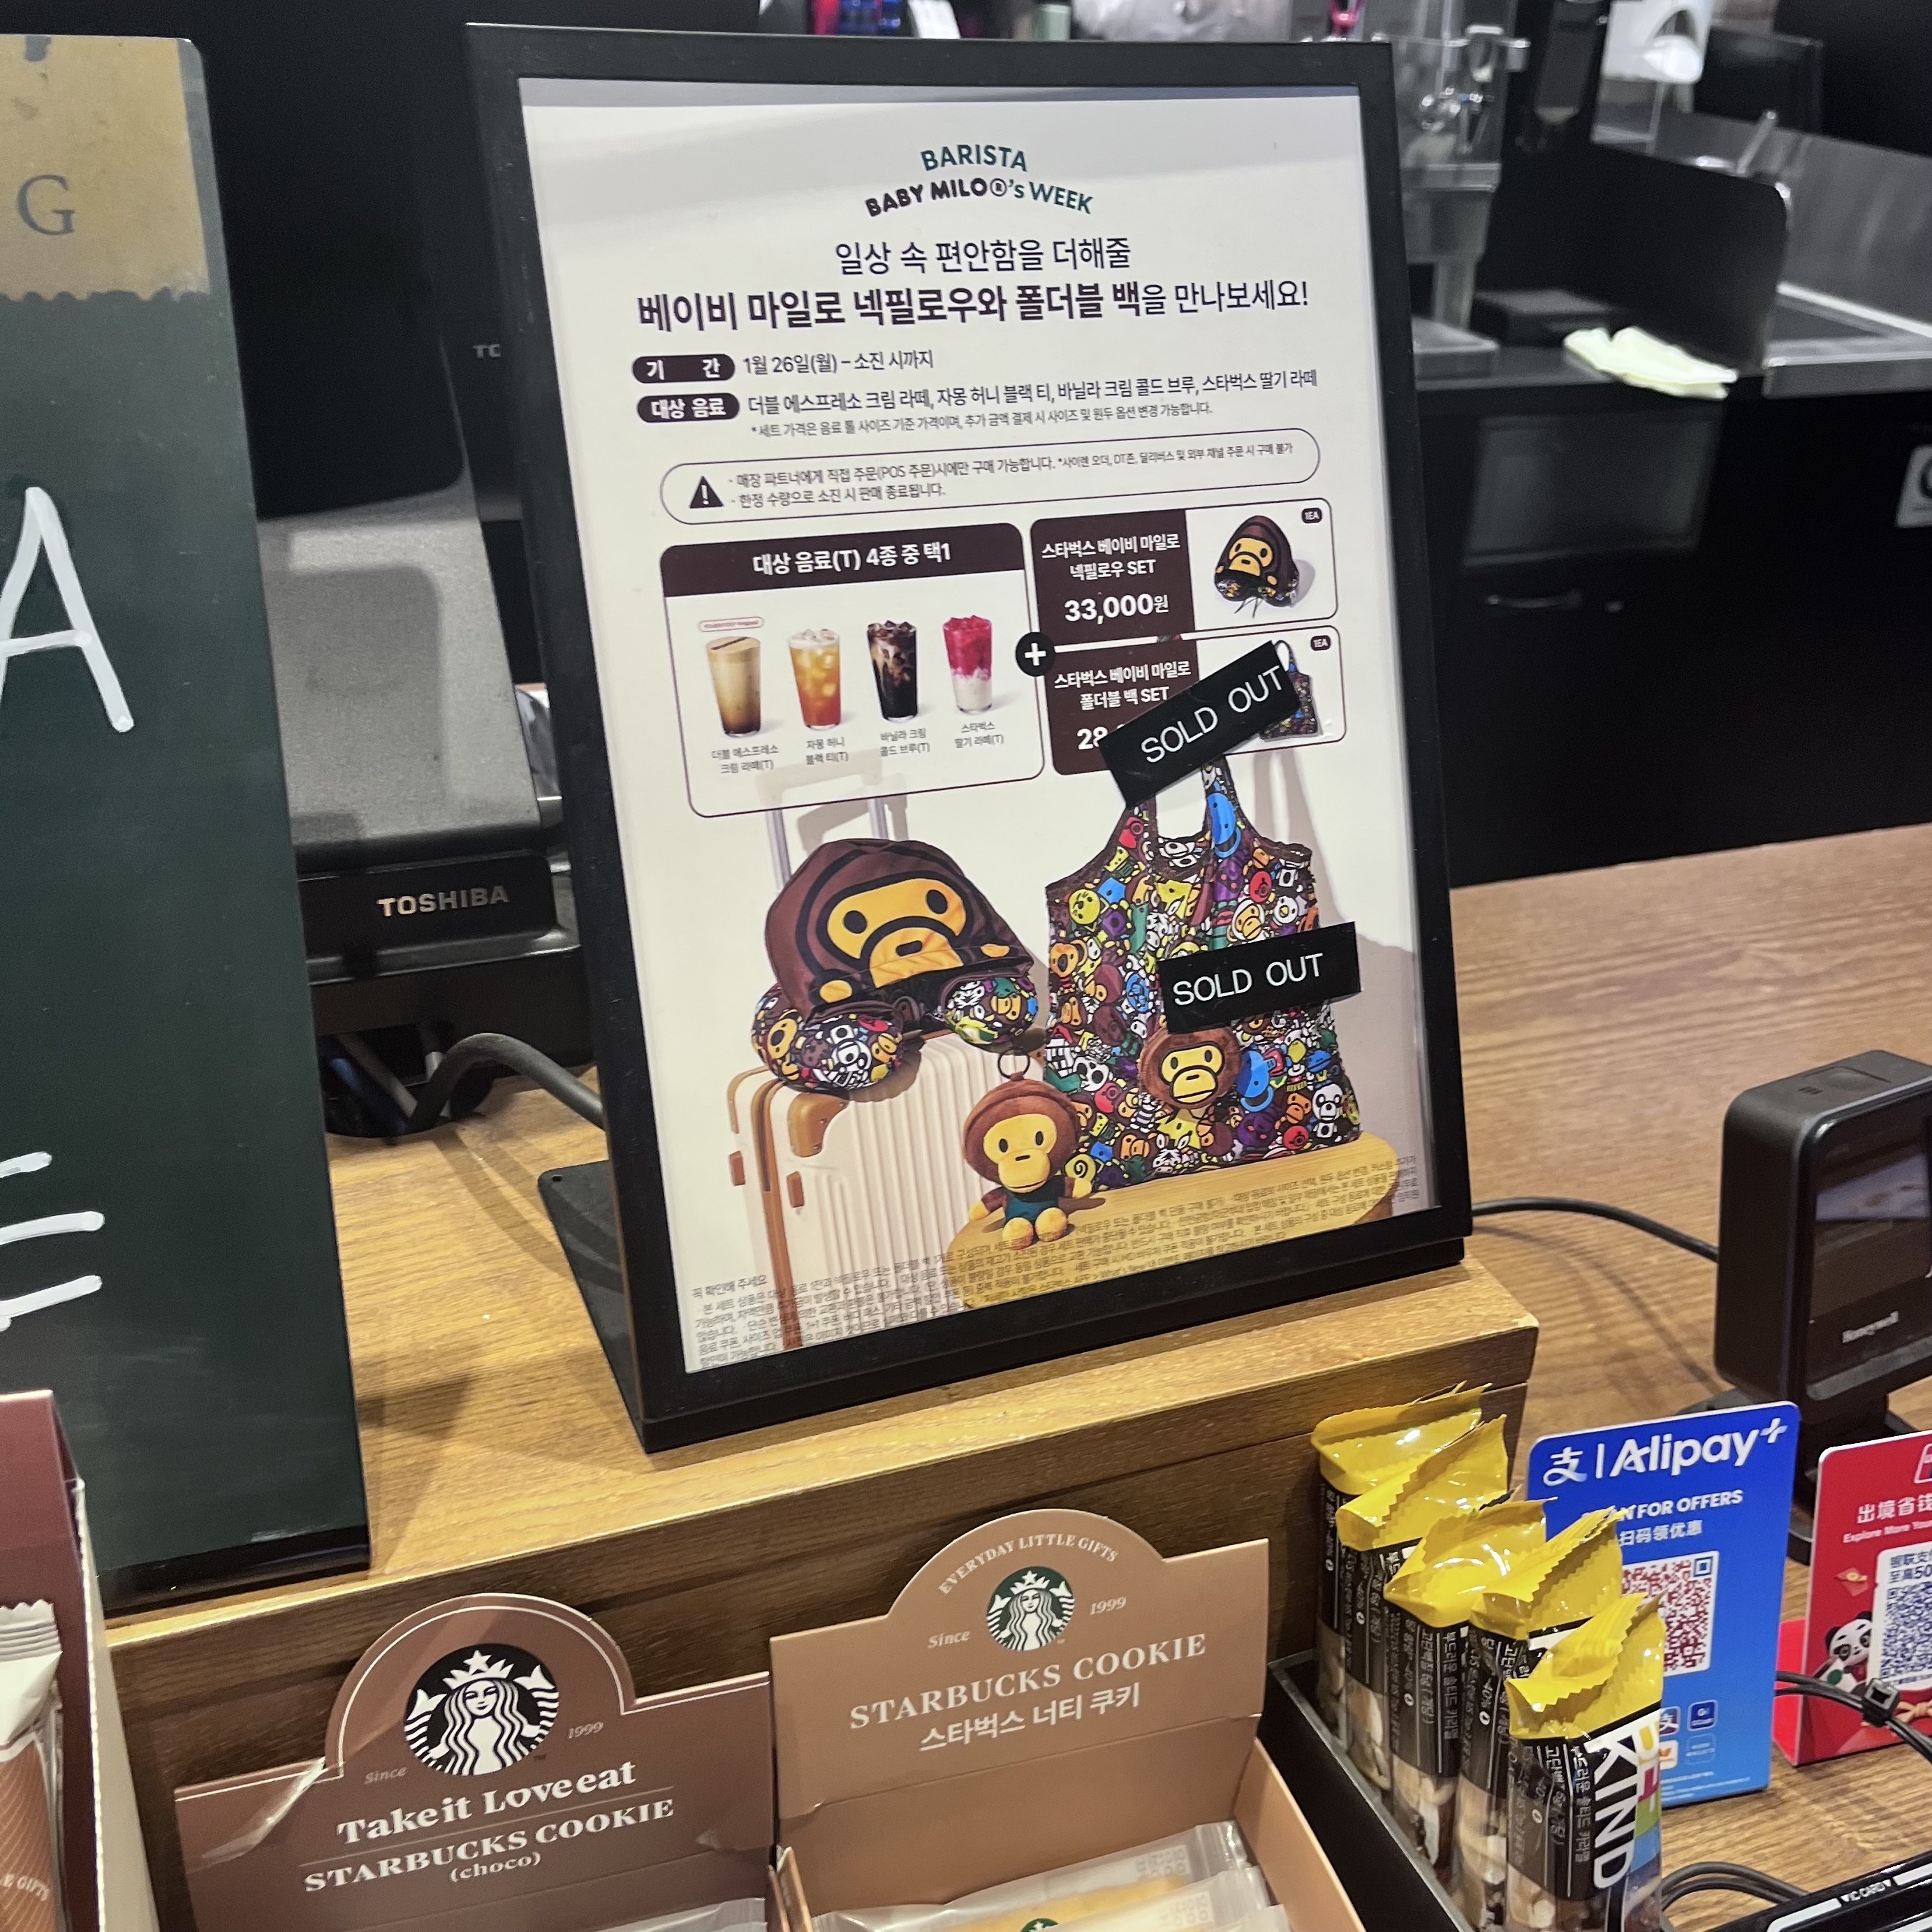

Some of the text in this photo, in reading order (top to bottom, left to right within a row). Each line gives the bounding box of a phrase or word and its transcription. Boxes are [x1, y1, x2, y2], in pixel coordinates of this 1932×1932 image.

[921, 144, 1027, 172] BARISTA
[865, 184, 924, 217] BABY
[1029, 181, 1094, 214] WEEK
[835, 237, 1131, 275] 일상 속 편안함을 더해줄
[637, 280, 1309, 332] 베이비 마일로 넥필로우와 폴더블 백을 만나보세요!
[742, 349, 935, 375] 1월 26일(월) 소진 시까지
[650, 396, 728, 421] 대상 음료
[747, 368, 1318, 415] 더블 에스프레소 크림 라떼, 자몽 허니 블랙 티, 바닐라 크림 콜드 브루, 스타벅스 딸기 라떼
[767, 490, 817, 507] 수량으로
[818, 488, 842, 503] 소진
[844, 487, 857, 502] 시
[752, 541, 951, 576] 대상 음료(T) 4종 중 택1
[1041, 533, 1181, 559] 스타벅스 베이비 마일로
[1069, 559, 1157, 581] 넥필로우 SET
[1064, 592, 1169, 626] 33,000원
[1053, 659, 1192, 689] 스타벅스 베이비 마일로
[1080, 685, 1171, 712] 폴더블 백 SET
[1140, 665, 1285, 764] SOLD OUT
[376, 884, 511, 918] TOSHIBA
[1172, 952, 1324, 1007] SOLD OUT
[1637, 1499, 1674, 1519] FOR
[1676, 1489, 1743, 1514] OFFERS
[1618, 1518, 1704, 1547] 扫码领优惠
[937, 1532, 1119, 1595] EVERYDAY LITTLE GIFTS
[926, 1596, 1127, 1651] Since 1999
[849, 1632, 1206, 1730] STARBUCKS COOKIE
[919, 1681, 1141, 1752] 스타벅스 너티 쿠키
[365, 1721, 604, 1785] Since 1999
[1583, 1718, 1637, 1889] KIND
[304, 1798, 675, 1892] STARBUCKS COOKIE
[449, 1851, 542, 1883] (choco)
